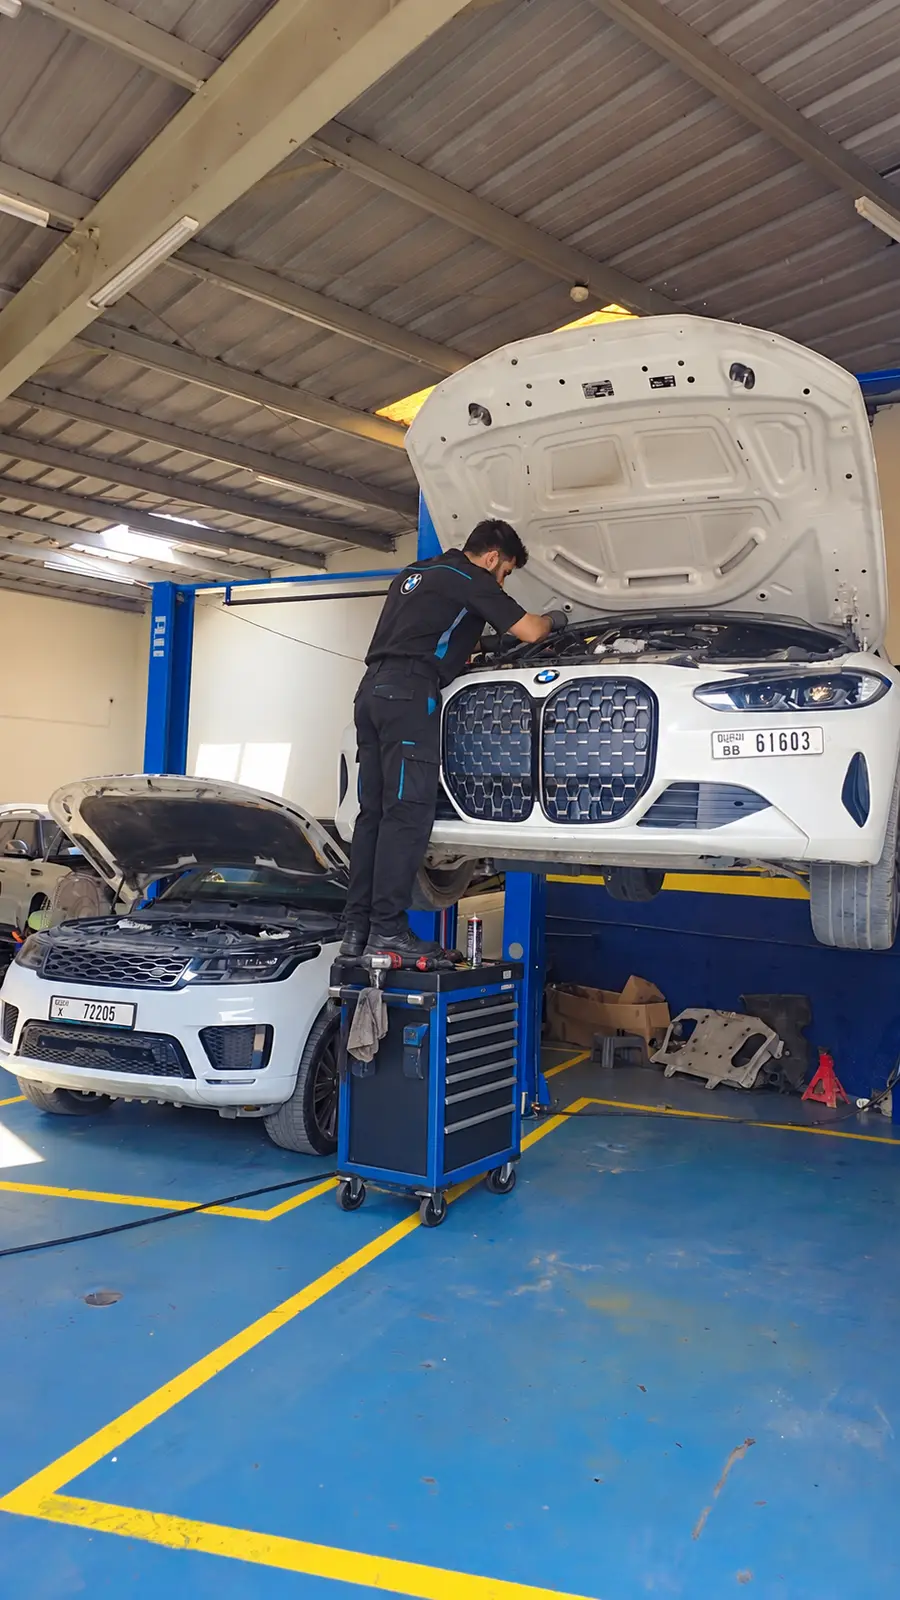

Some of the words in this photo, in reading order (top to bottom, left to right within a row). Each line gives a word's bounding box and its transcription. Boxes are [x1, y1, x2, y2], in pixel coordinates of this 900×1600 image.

[756, 731, 810, 752] 61603
[723, 745, 740, 756] BB
[57, 1007, 64, 1016] X
[83, 1003, 115, 1021] 72205
